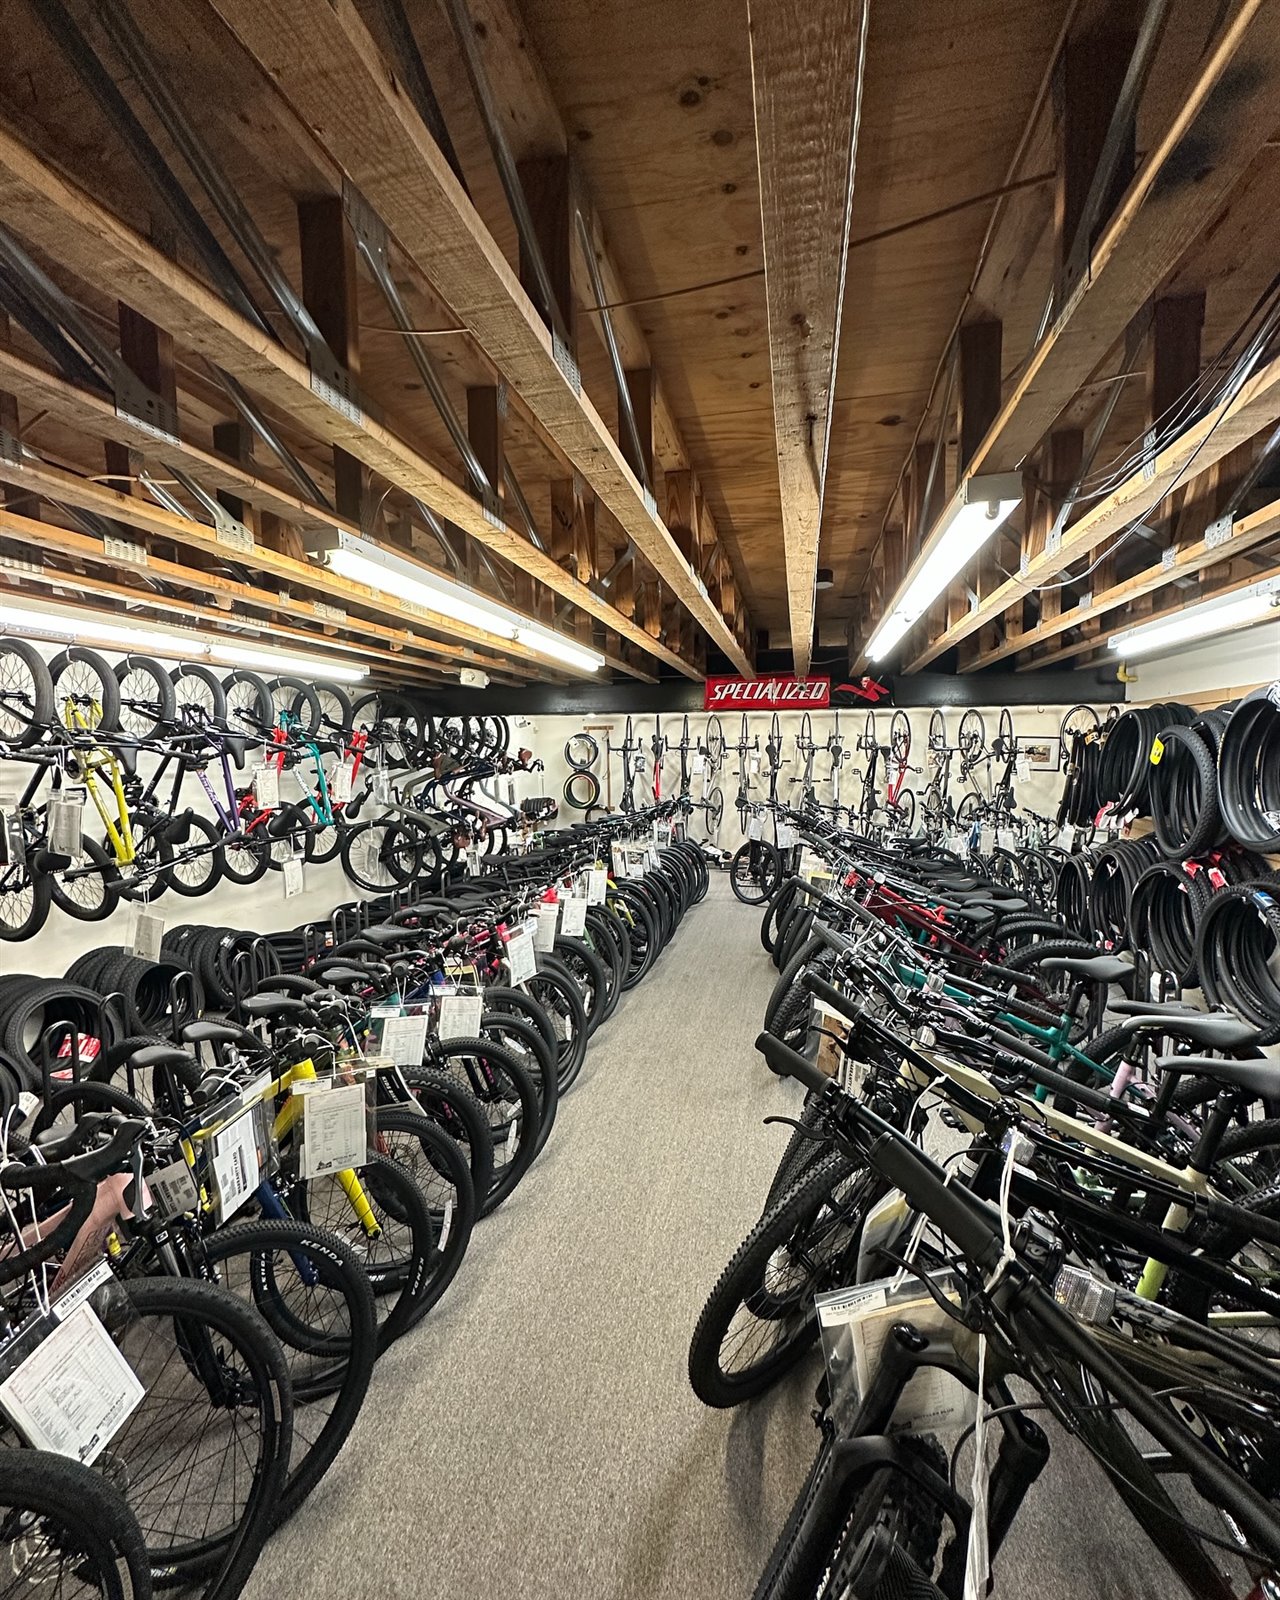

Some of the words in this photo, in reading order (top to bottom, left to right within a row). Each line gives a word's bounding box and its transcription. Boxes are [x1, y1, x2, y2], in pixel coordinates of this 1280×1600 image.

[709, 682, 828, 701] SPECIALIZED
[300, 1239, 344, 1267] KENDA
[411, 1257, 425, 1296] KENDA
